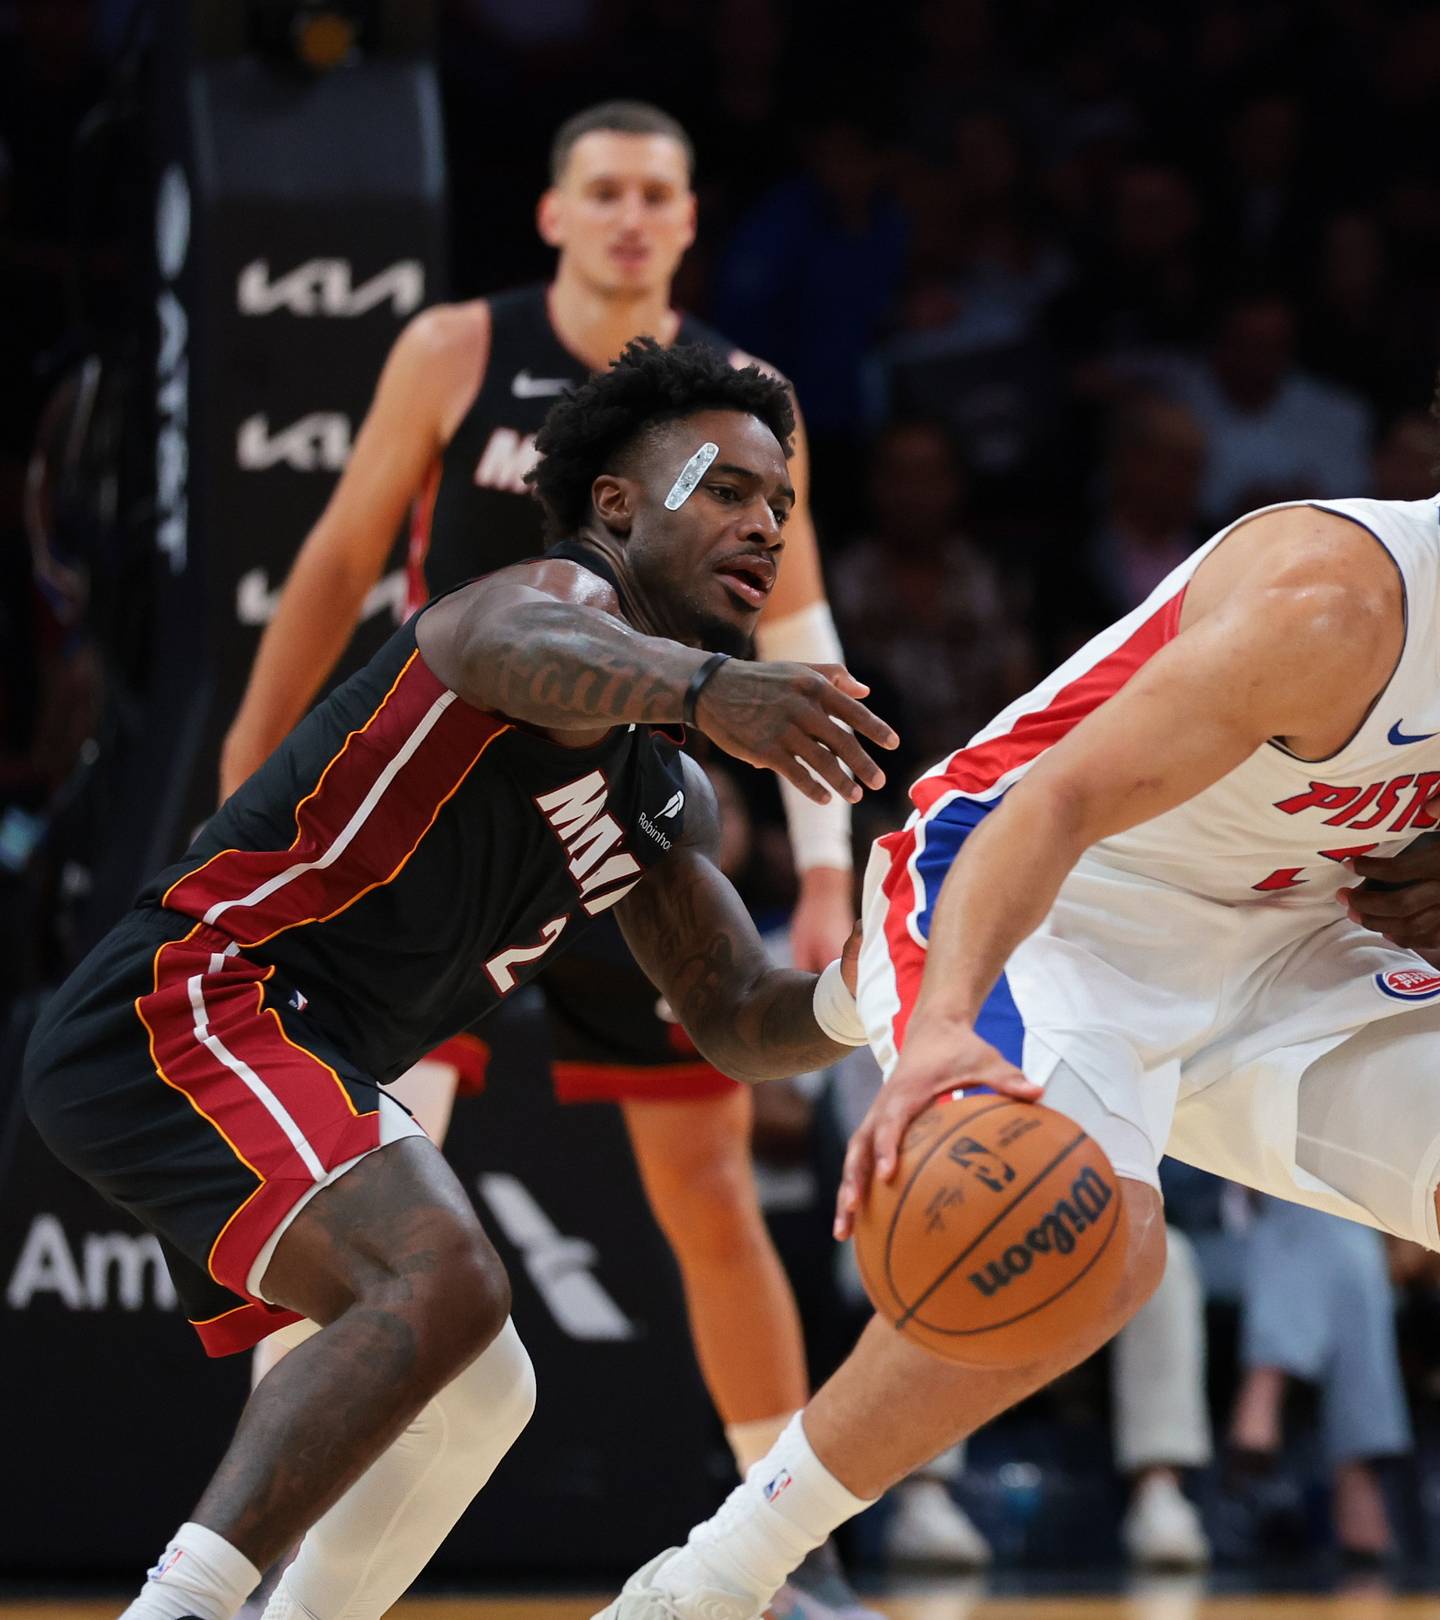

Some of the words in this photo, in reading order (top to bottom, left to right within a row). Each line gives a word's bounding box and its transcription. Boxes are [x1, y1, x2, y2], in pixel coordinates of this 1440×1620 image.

[236, 411, 353, 472] KI
[638, 811, 672, 850] Robinho
[485, 914, 568, 994] 2
[7, 1212, 179, 1311] Am
[969, 1165, 1112, 1296] Wilson
